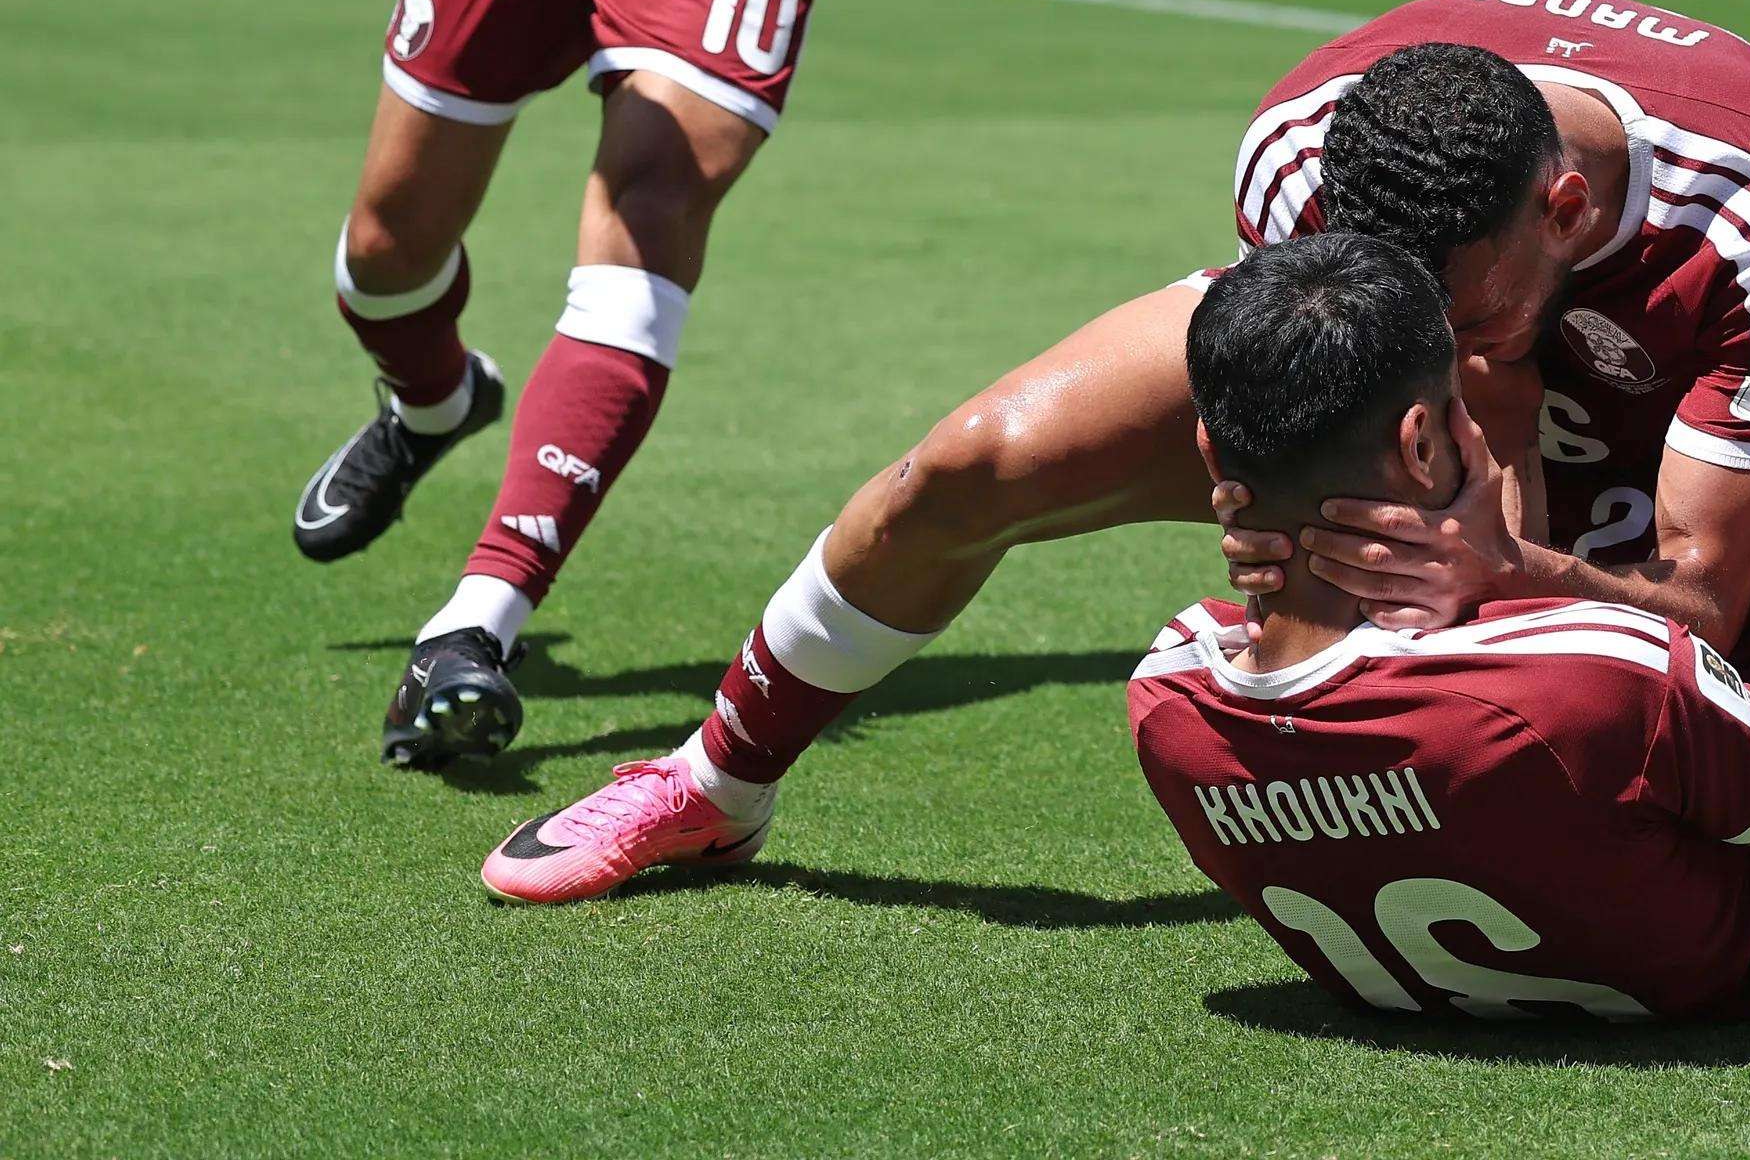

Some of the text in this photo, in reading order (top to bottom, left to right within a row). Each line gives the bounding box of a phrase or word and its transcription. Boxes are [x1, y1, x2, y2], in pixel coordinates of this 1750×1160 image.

[1594, 360, 1638, 380] QFA
[537, 443, 600, 494] QFA
[1195, 767, 1441, 846] KHOUKHI
